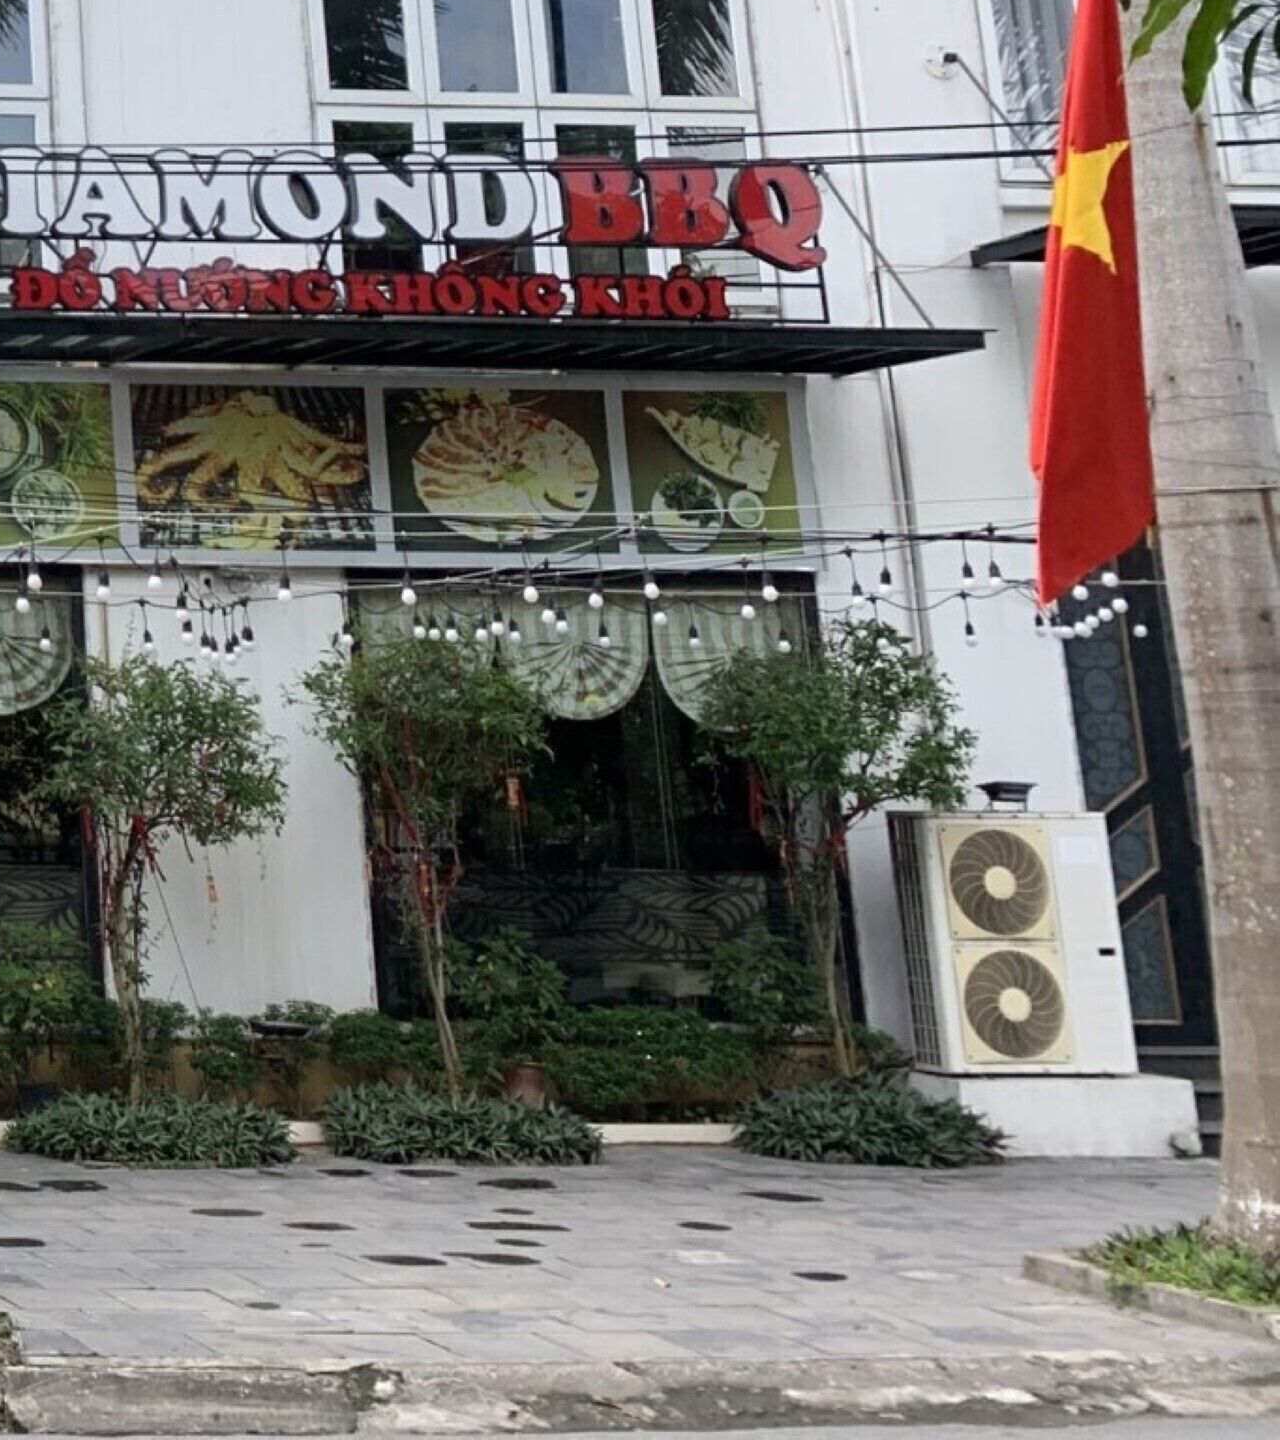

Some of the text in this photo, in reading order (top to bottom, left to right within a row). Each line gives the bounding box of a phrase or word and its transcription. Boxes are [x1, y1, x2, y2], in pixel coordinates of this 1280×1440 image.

[553, 155, 828, 272] BBQ
[342, 261, 567, 318] KHÔNG
[573, 264, 731, 321] KHÓI
